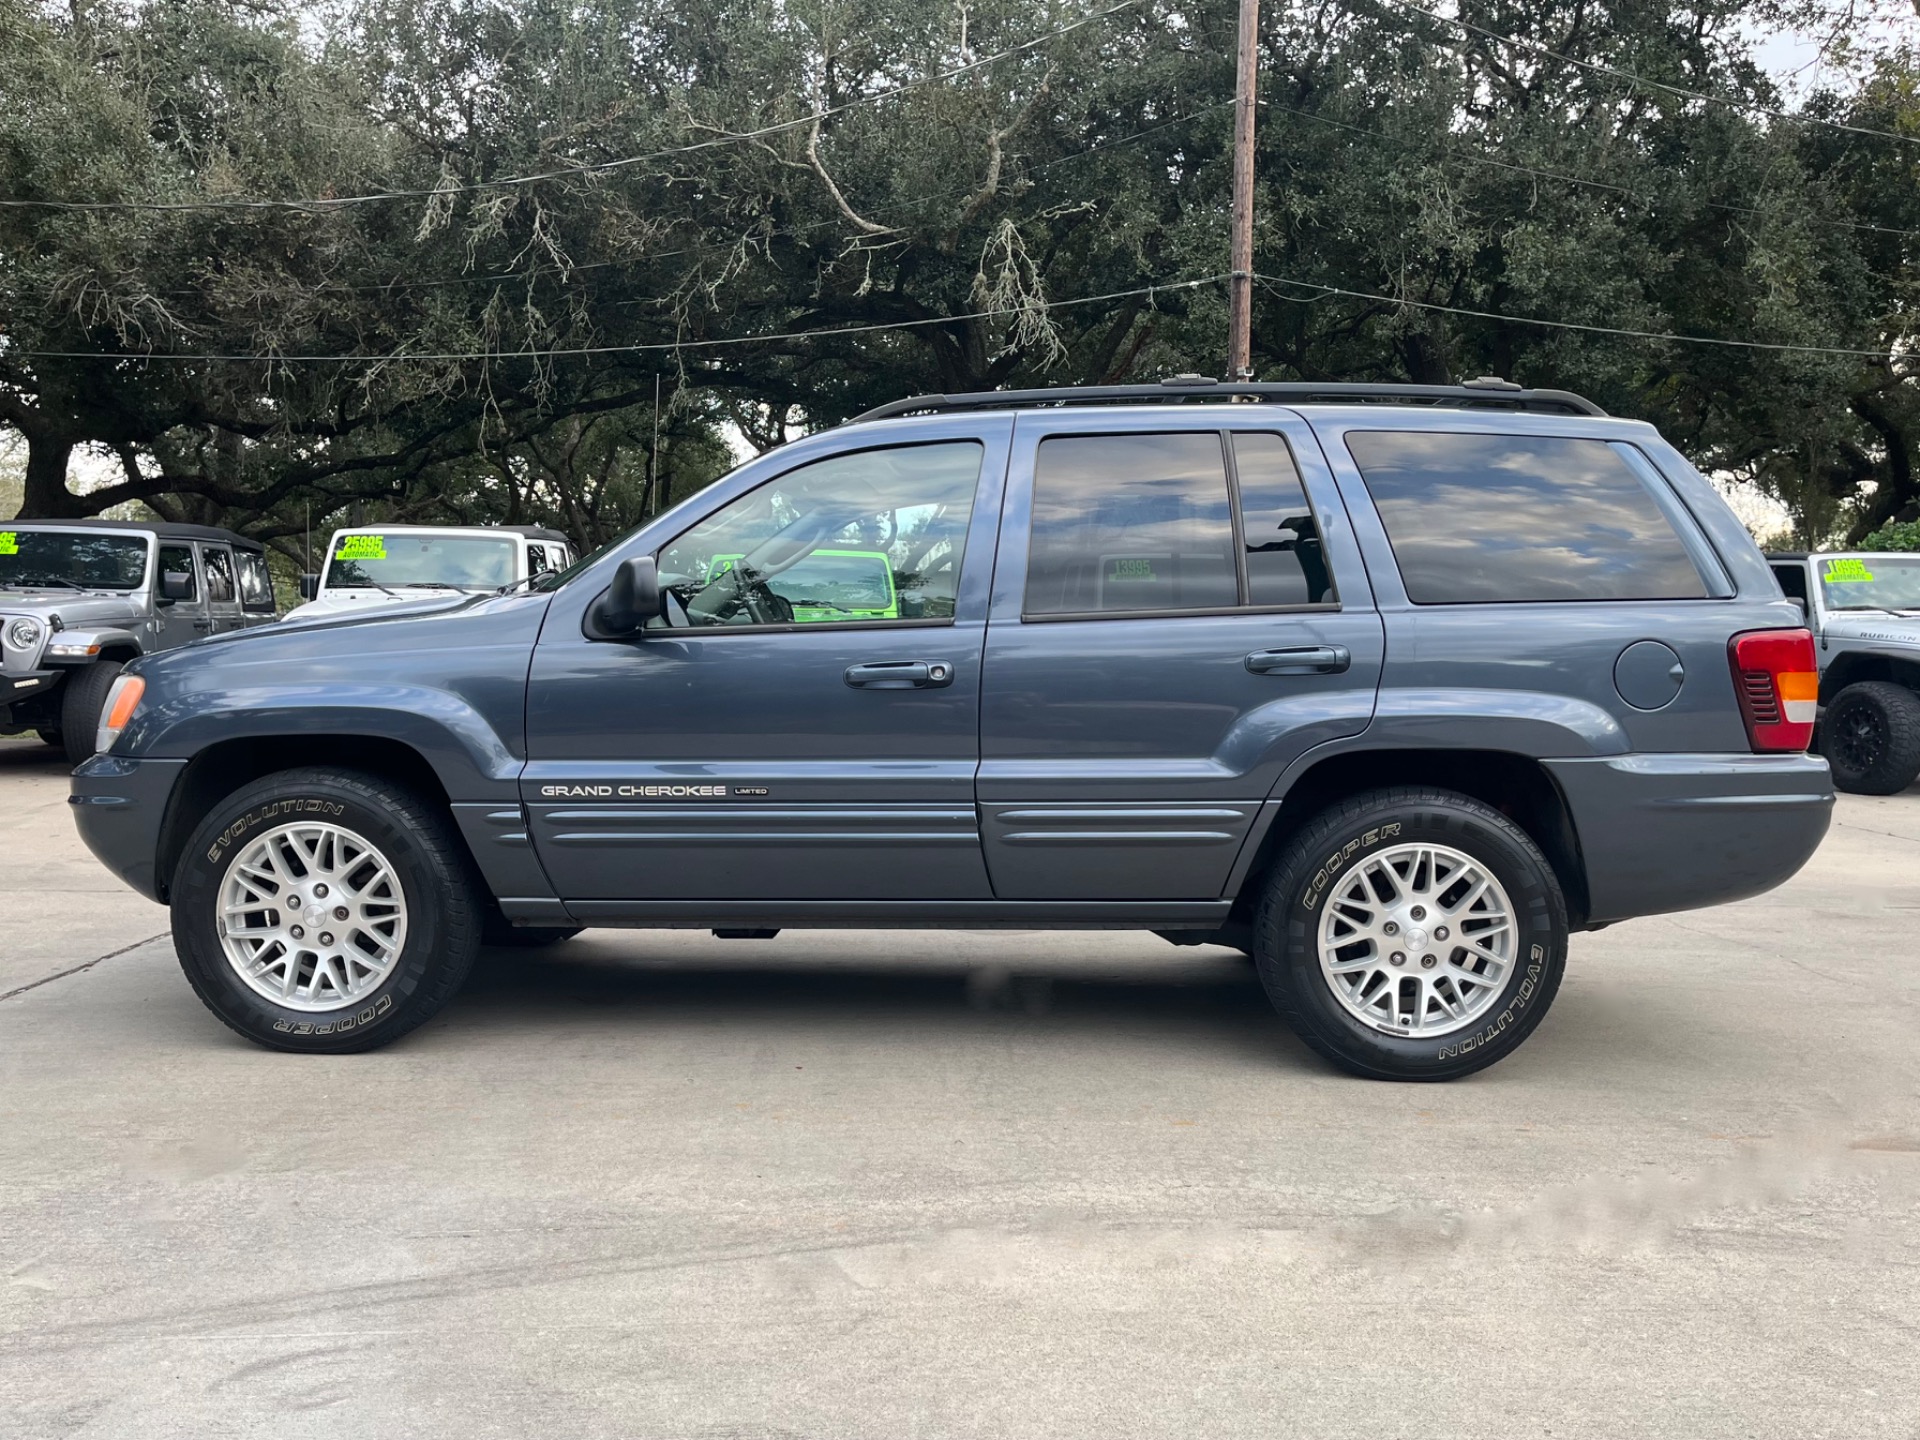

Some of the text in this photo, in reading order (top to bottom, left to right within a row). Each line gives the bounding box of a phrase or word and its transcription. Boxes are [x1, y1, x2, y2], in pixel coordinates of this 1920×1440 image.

[344, 536, 384, 551] 25995
[1115, 560, 1150, 575] 13995
[1827, 559, 1866, 574] 18995
[1860, 631, 1917, 642] RUBICON
[541, 785, 613, 797] GRAND
[617, 785, 727, 797] CHEROKEE
[207, 798, 345, 864] EVOLUTION
[1302, 822, 1402, 911] COOPER
[1438, 943, 1545, 1060] EVOLUTION
[272, 994, 393, 1036] COOPER
